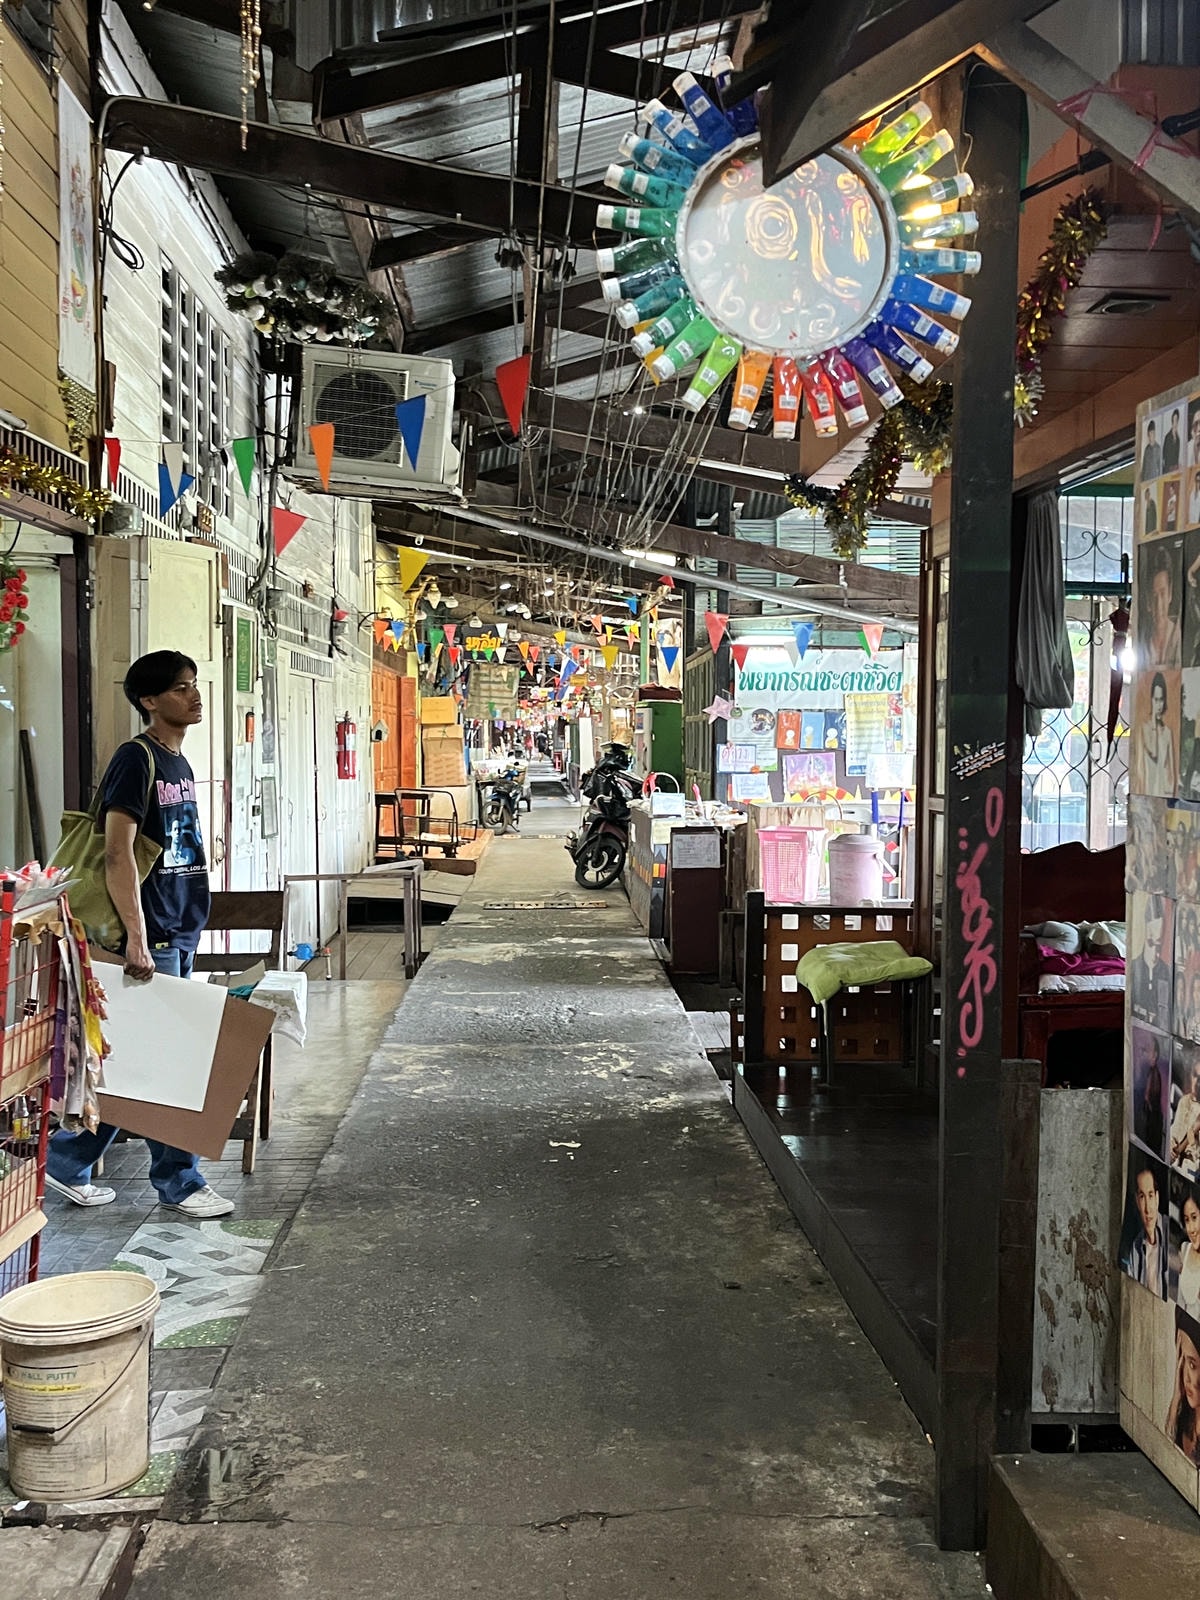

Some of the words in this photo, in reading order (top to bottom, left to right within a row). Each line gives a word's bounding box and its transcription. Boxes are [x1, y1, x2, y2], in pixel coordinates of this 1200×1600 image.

[738, 656, 904, 692] พยากรณ์ชะตาชีวิต
[46, 1371, 78, 1381] PUTTY
